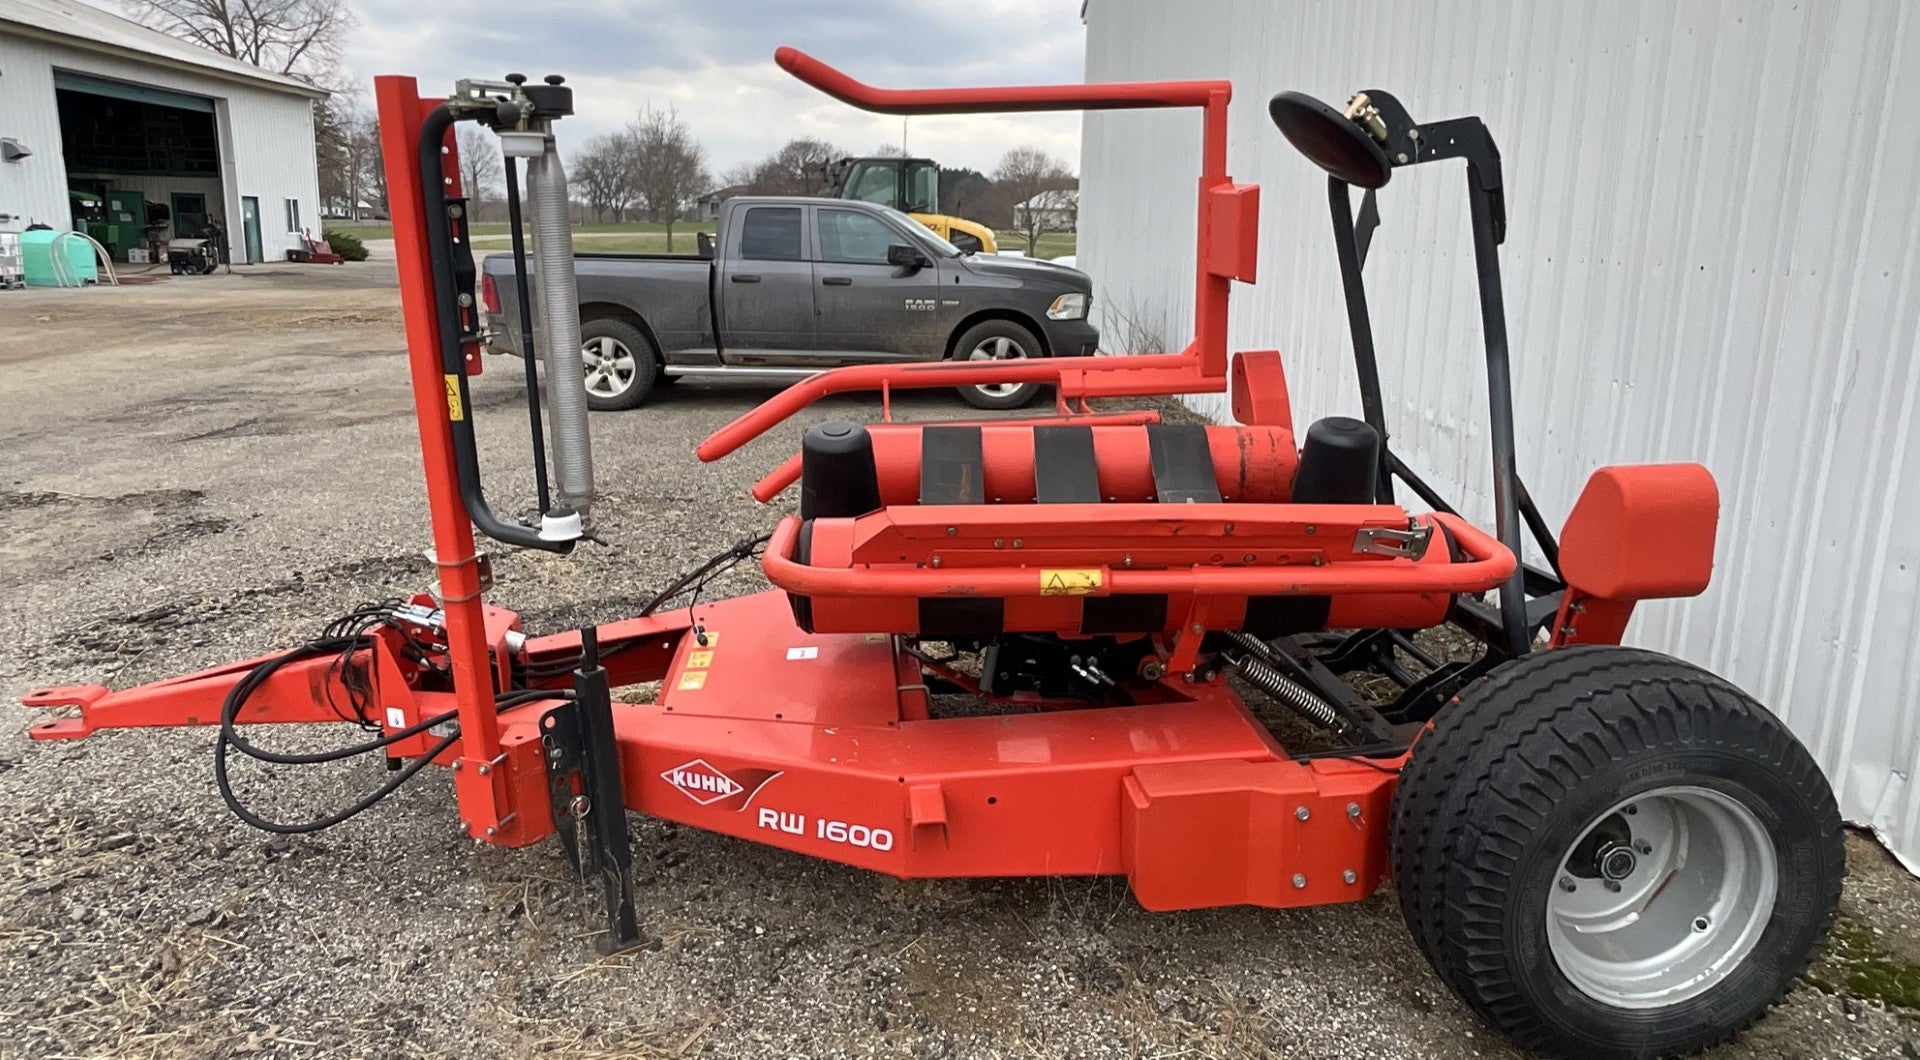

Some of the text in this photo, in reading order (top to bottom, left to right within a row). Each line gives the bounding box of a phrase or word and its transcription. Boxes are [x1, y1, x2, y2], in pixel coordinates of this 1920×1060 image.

[672, 770, 731, 793] KUHN
[758, 807, 893, 851] RW 1600
